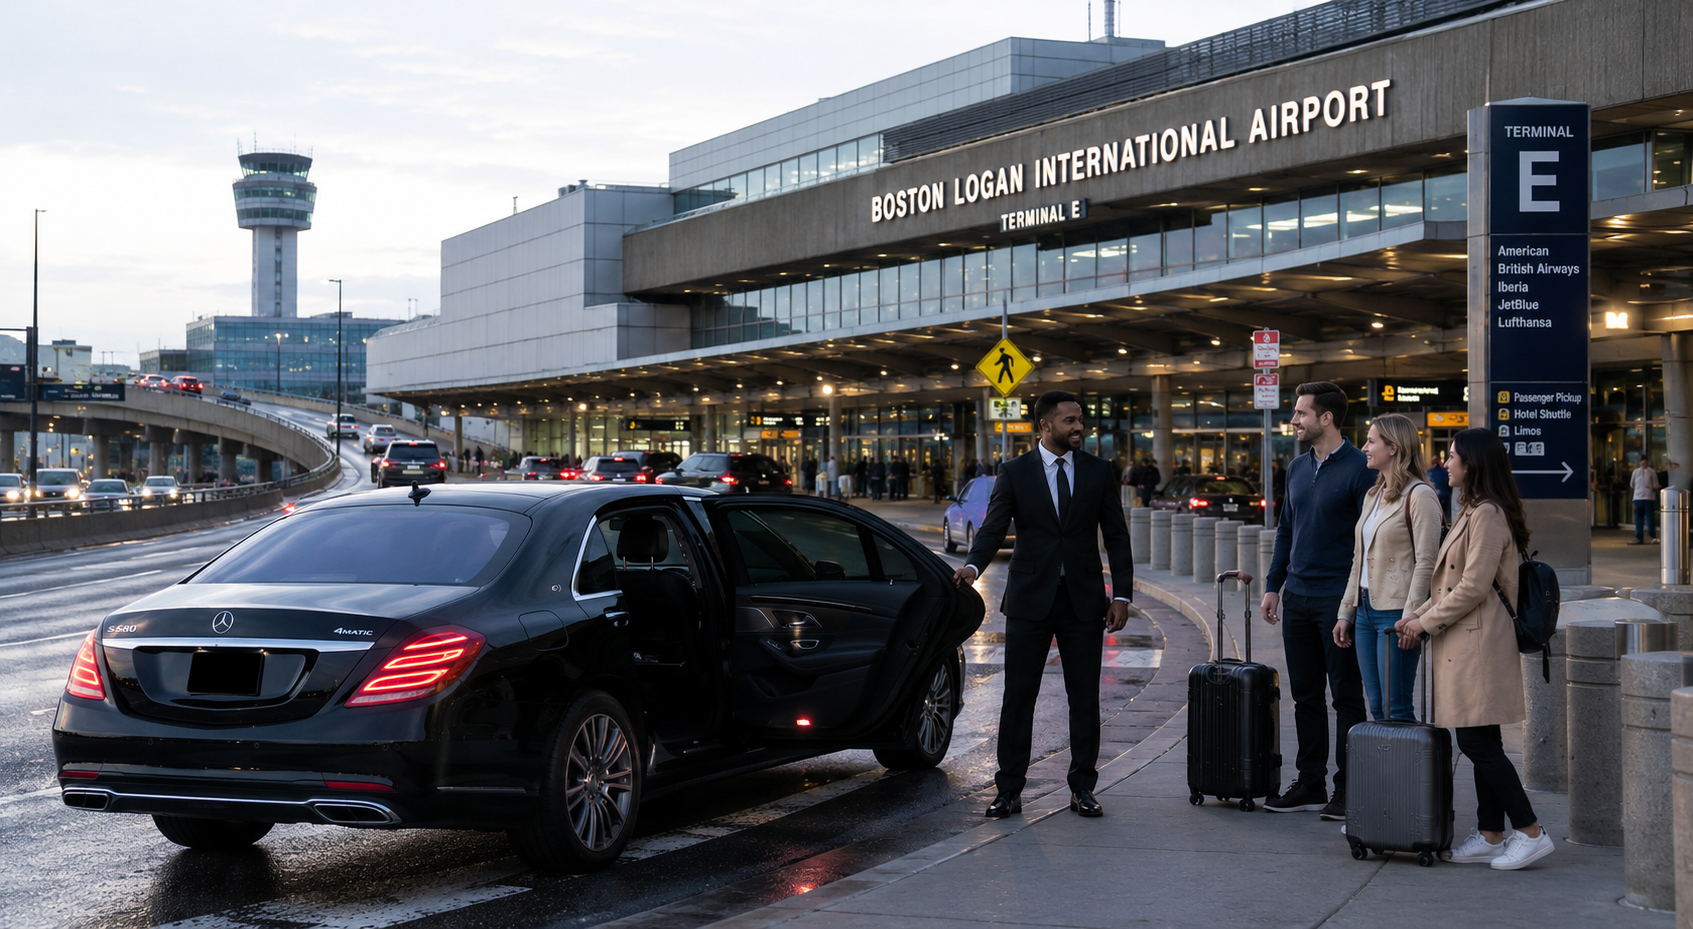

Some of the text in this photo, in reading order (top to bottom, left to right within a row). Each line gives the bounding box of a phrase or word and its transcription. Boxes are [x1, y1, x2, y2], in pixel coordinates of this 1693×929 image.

[1504, 125, 1574, 138] TERMINAL
[871, 78, 1391, 223] BOSTON LOGAN INTERNATIONAL AIRPORT
[1519, 150, 1560, 212] E
[1001, 200, 1081, 231] TERMINAL E
[1498, 245, 1549, 256] American
[1498, 263, 1580, 277] British Airways
[1498, 281, 1529, 292] Iberia
[1498, 299, 1539, 310] JetBlue
[1498, 316, 1552, 328] Lufthansa
[1514, 392, 1554, 405] Passenger
[1514, 409, 1572, 419] Hotel Shuttle
[1514, 425, 1541, 436] Limos
[333, 627, 374, 636] 4MATIC
